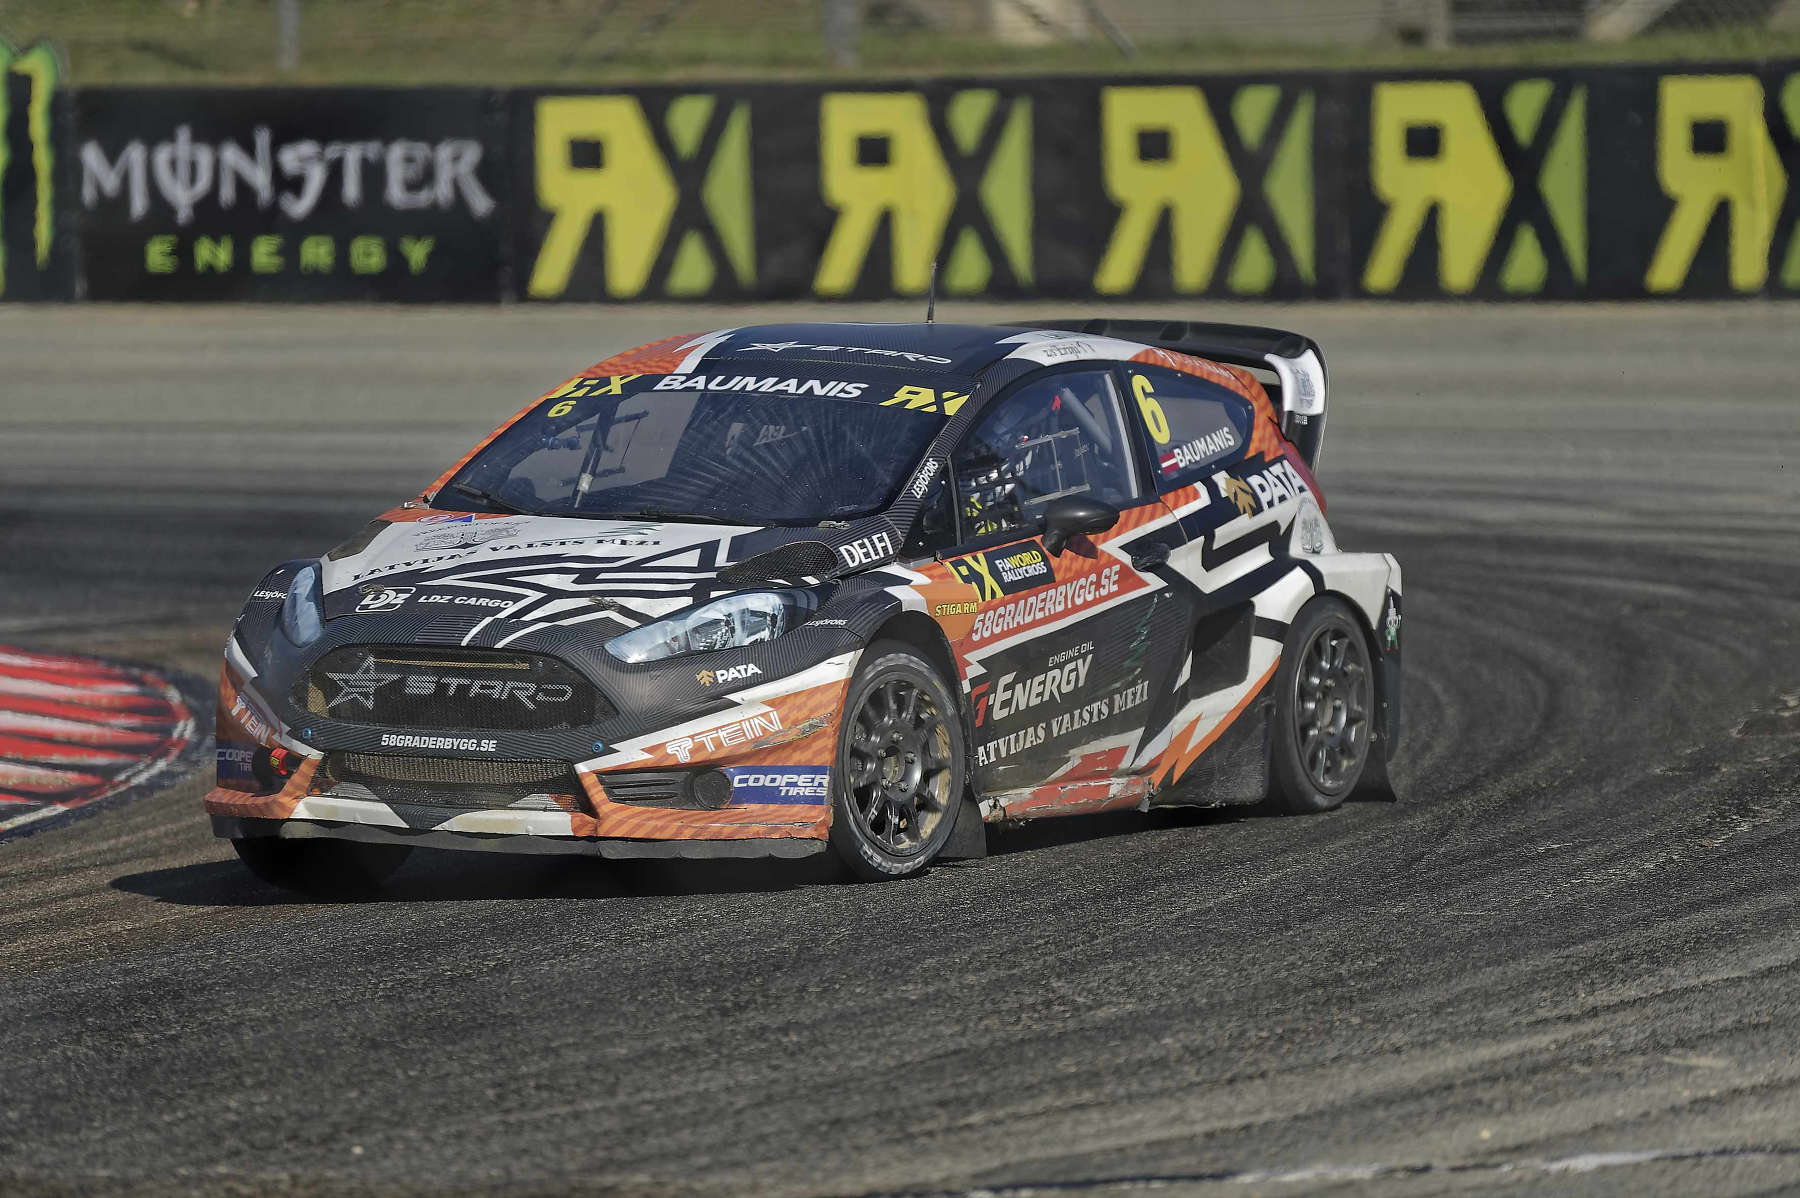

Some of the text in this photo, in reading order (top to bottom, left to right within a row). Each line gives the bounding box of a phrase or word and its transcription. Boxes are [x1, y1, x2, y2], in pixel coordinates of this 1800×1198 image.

[80, 124, 495, 225] MONSTER
[145, 235, 435, 273] ENERGY
[653, 375, 869, 398] BAUMANIS
[548, 400, 577, 418] 6
[1131, 374, 1171, 445] 6
[1173, 426, 1235, 468] BAUMANIS
[1246, 458, 1311, 513] PATA
[839, 531, 894, 568] DELFI
[1001, 561, 1048, 583] RALLYCROSS
[417, 595, 515, 610] LDZ CARGO
[935, 602, 978, 617] STIGA RM
[971, 564, 1121, 642] 58GRADERBYGG.SE
[1048, 640, 1095, 667] ENGINE OIL
[715, 663, 763, 684] PATA
[404, 675, 573, 711] STARD
[976, 680, 1150, 767] ATVIJAS VALSTS MEŽI
[216, 748, 253, 762] COOPE
[380, 734, 497, 752] 58GRADERBYGG.SE
[733, 774, 830, 788] COOPER
[779, 787, 828, 796] TIRES
